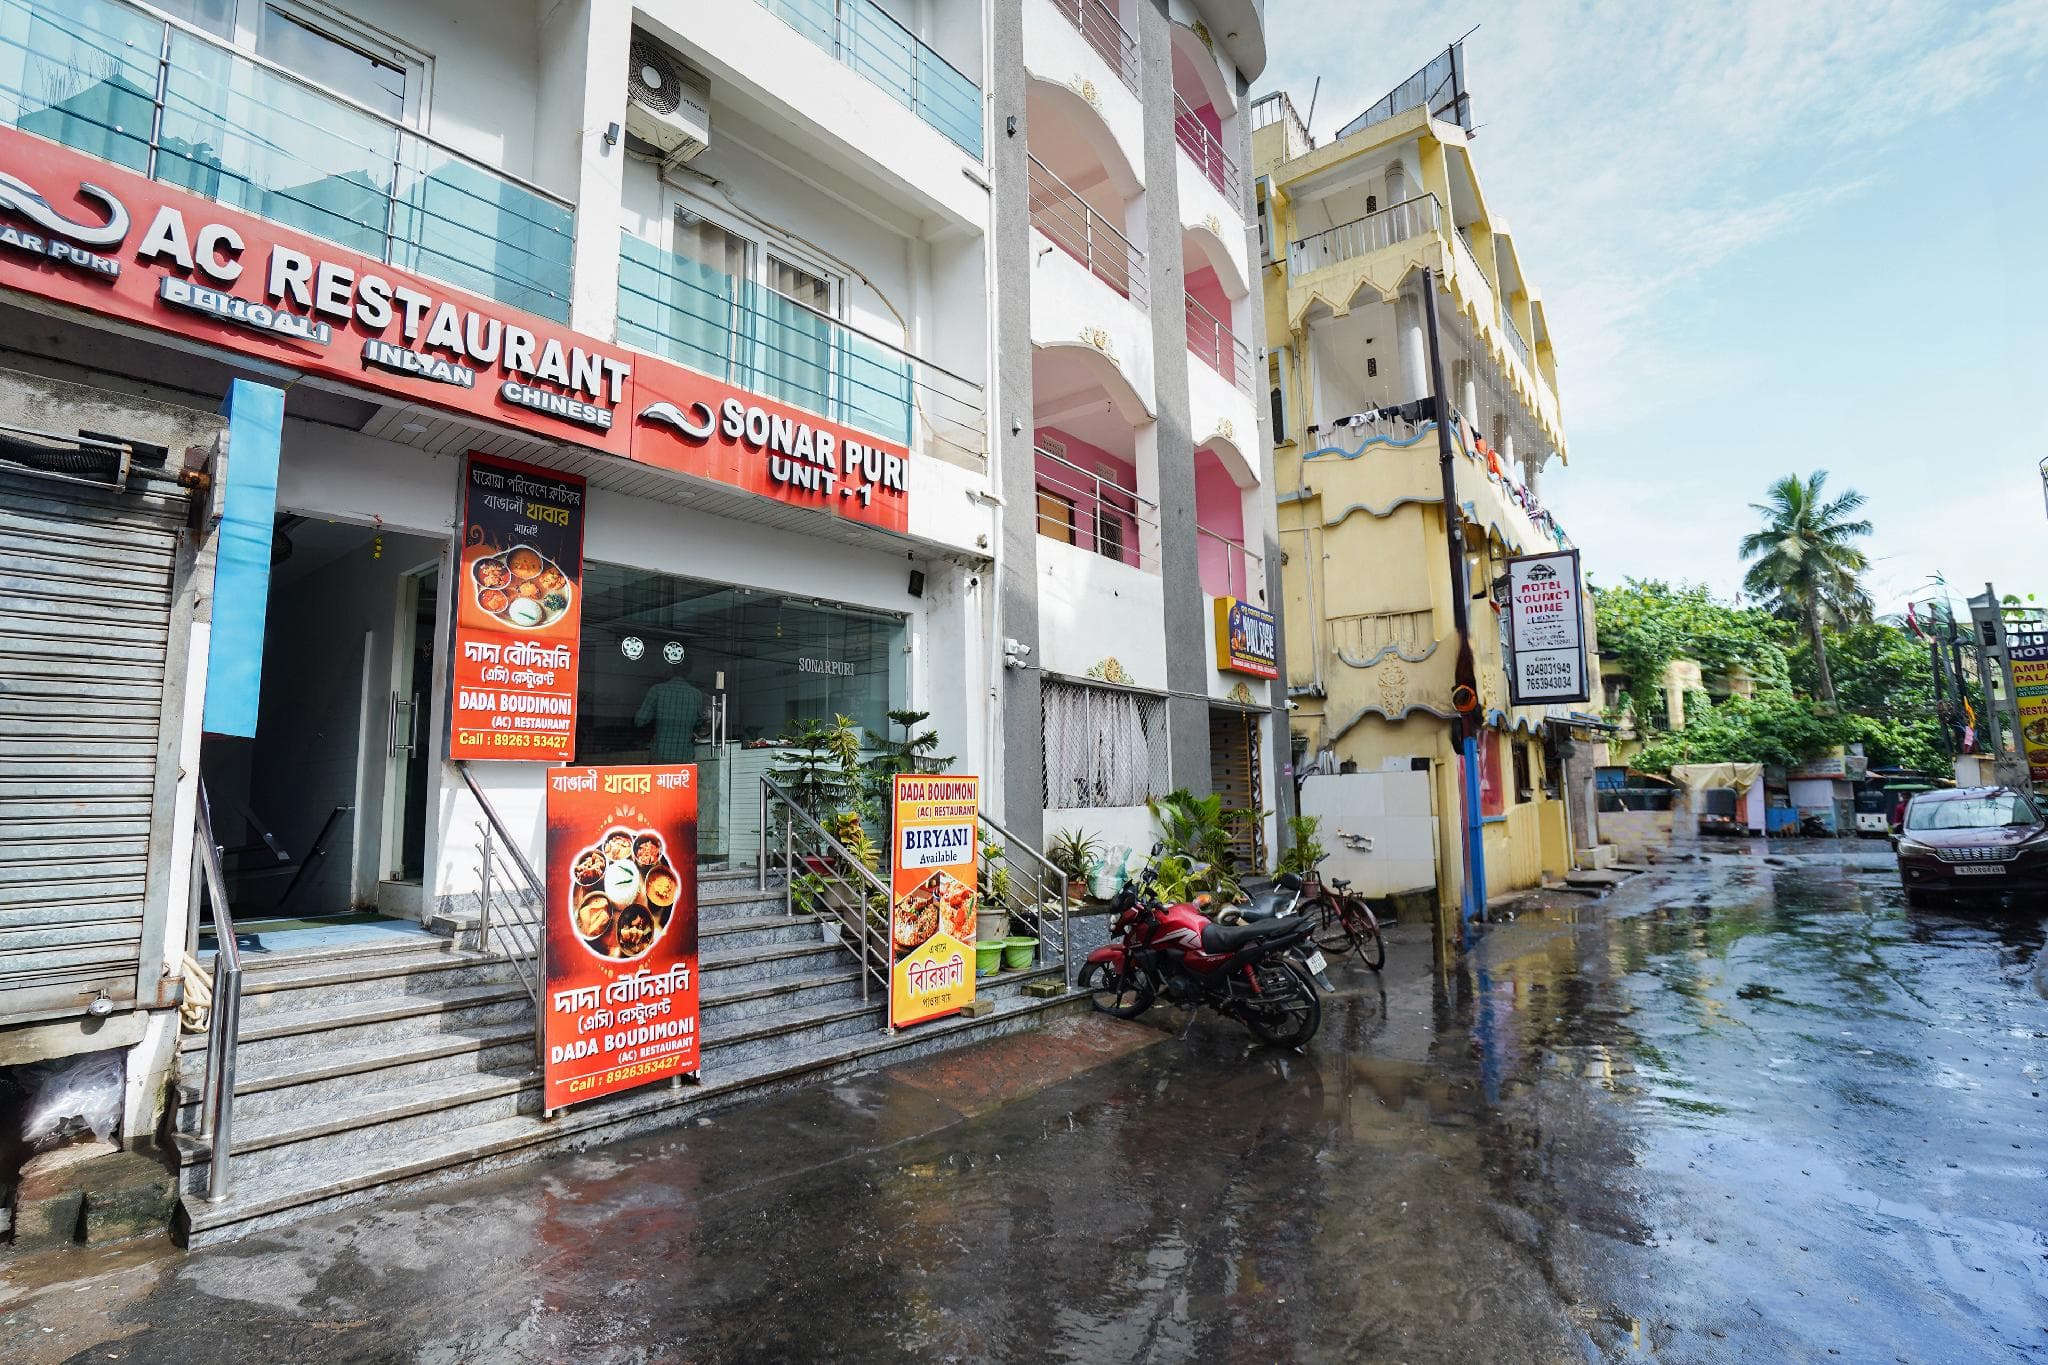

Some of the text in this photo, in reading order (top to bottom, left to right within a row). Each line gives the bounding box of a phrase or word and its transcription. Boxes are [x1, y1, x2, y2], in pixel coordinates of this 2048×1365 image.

[52, 240, 119, 275] PURI
[138, 205, 631, 404] AC RESTAURANT
[503, 382, 613, 429] CHINESE
[722, 398, 909, 492] SONAR PURI
[771, 456, 838, 495] UNIT
[527, 502, 570, 526] খাবার
[464, 641, 502, 664] দাদা
[2010, 646, 2048, 659] HOT
[798, 657, 855, 676] SONARPURI
[2014, 662, 2048, 673] AMB
[459, 691, 571, 715] DADA BOUDIMONI
[492, 716, 571, 730] (AC) RESTAURANT
[459, 733, 483, 745] Call
[494, 734, 530, 746] 89263
[533, 736, 568, 748] 53427
[605, 774, 652, 795] খাবার
[656, 770, 690, 789] মানেই
[901, 783, 976, 801] DADA BOUDIMONI
[918, 805, 976, 818] (AC) RESTAURANT
[905, 828, 968, 850] BIRYANI
[920, 850, 958, 864] Available
[553, 985, 602, 1014] দাদা
[578, 1009, 614, 1035] (এসি)
[551, 1017, 694, 1064] DADA BOUDIMONI
[618, 1036, 694, 1065] (AC) RESTAURANT
[569, 1077, 595, 1093] Call
[606, 1055, 681, 1084] 8926353427
